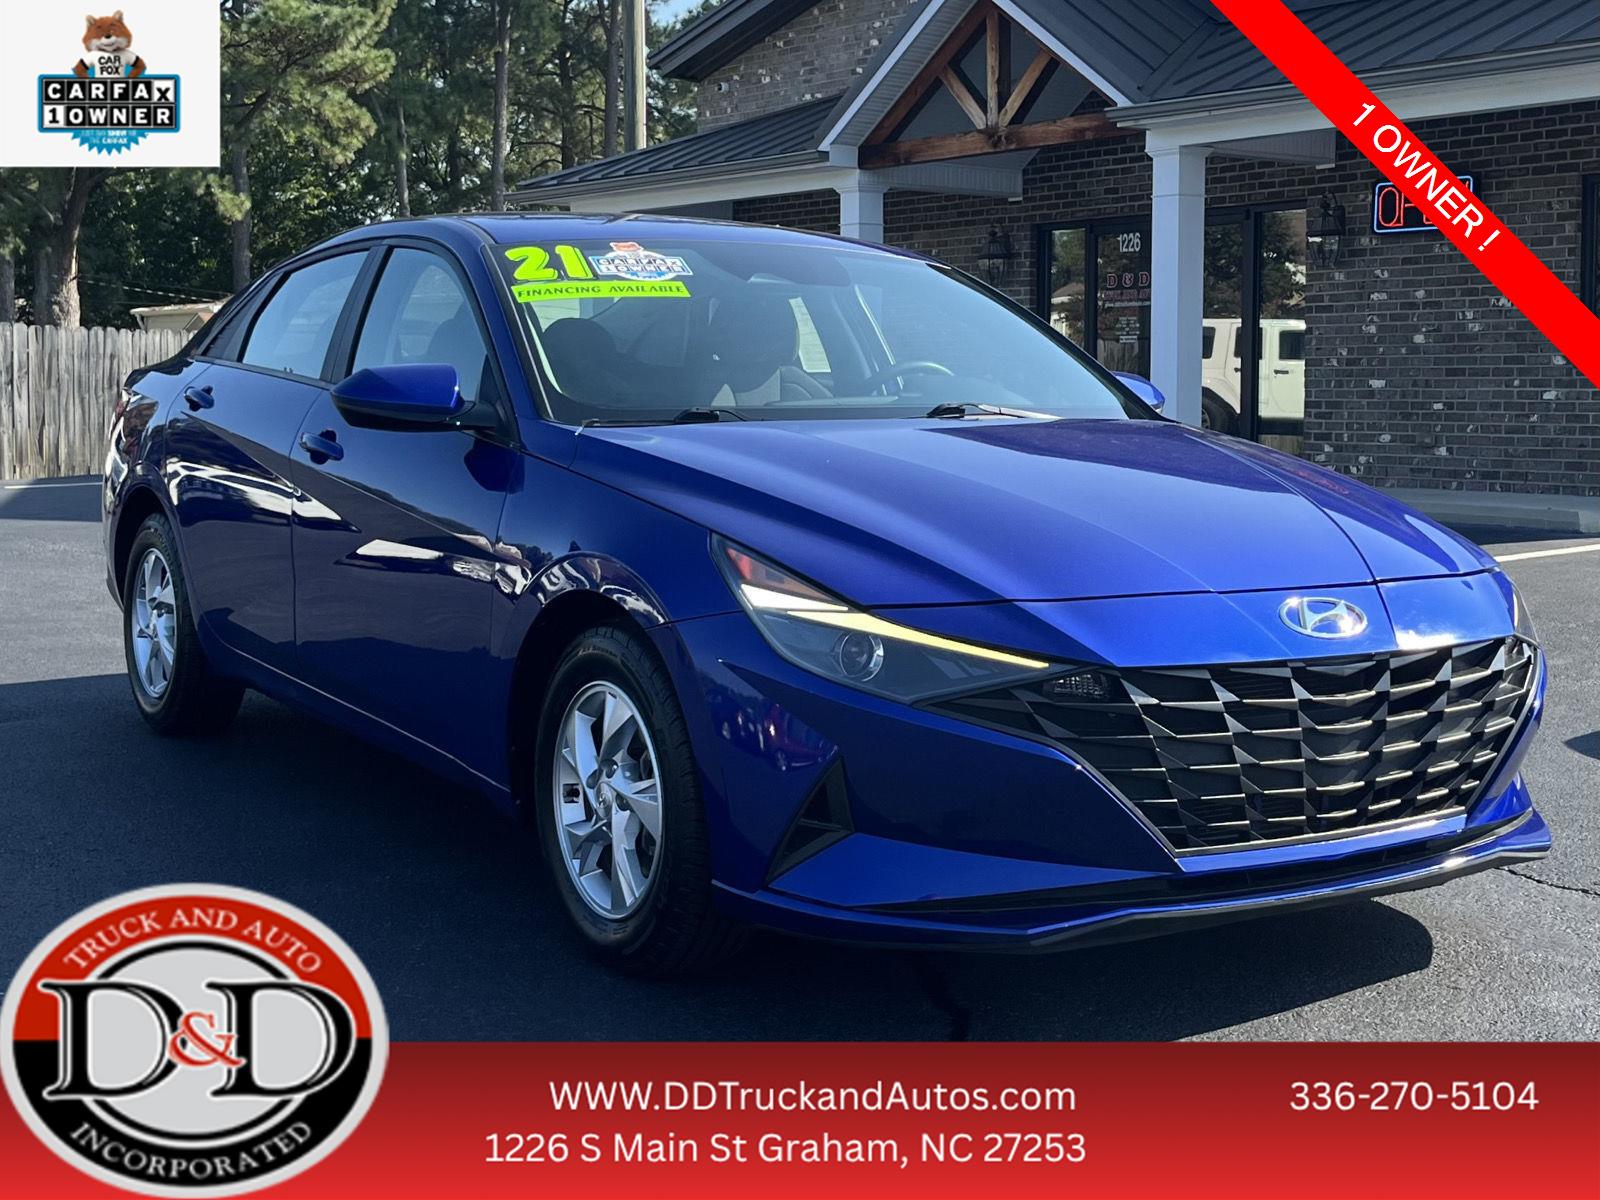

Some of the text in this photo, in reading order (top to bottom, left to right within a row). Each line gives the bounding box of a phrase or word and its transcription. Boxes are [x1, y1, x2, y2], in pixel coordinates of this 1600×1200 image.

[1117, 232, 1141, 252] 1226
[504, 245, 594, 281] 21
[518, 284, 685, 298] FINANCING AVAILABLE
